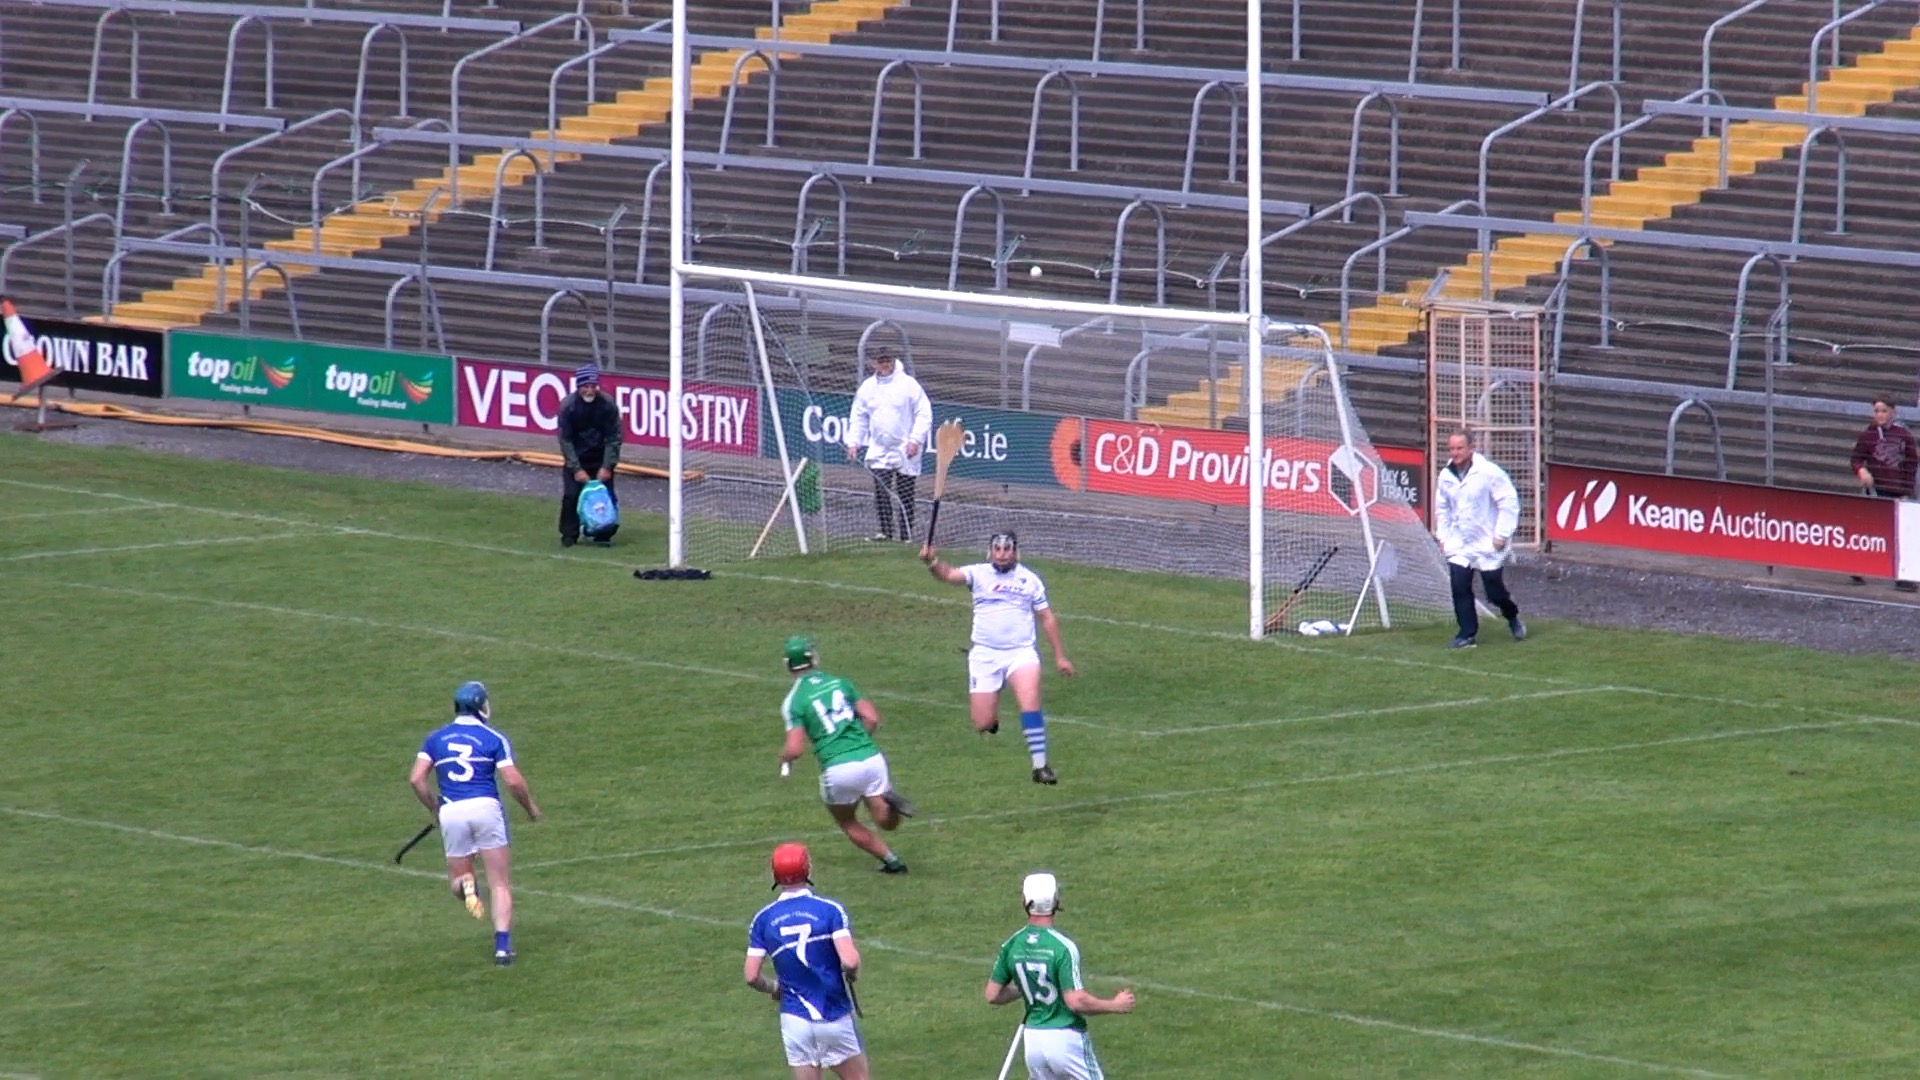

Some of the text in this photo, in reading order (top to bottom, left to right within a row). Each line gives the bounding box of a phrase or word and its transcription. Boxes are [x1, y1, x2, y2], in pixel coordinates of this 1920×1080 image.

[2, 334, 148, 380] COWN BAR
[616, 386, 749, 445] FORSTRY
[1095, 433, 1159, 476] C&D
[1381, 484, 1417, 502] TRADE
[1400, 470, 1409, 485] &
[1628, 495, 1886, 553] Keane Auctioneers.com
[812, 689, 854, 734] 14
[447, 742, 474, 782] 3
[780, 923, 811, 967] 7
[1015, 962, 1058, 1005] 13
